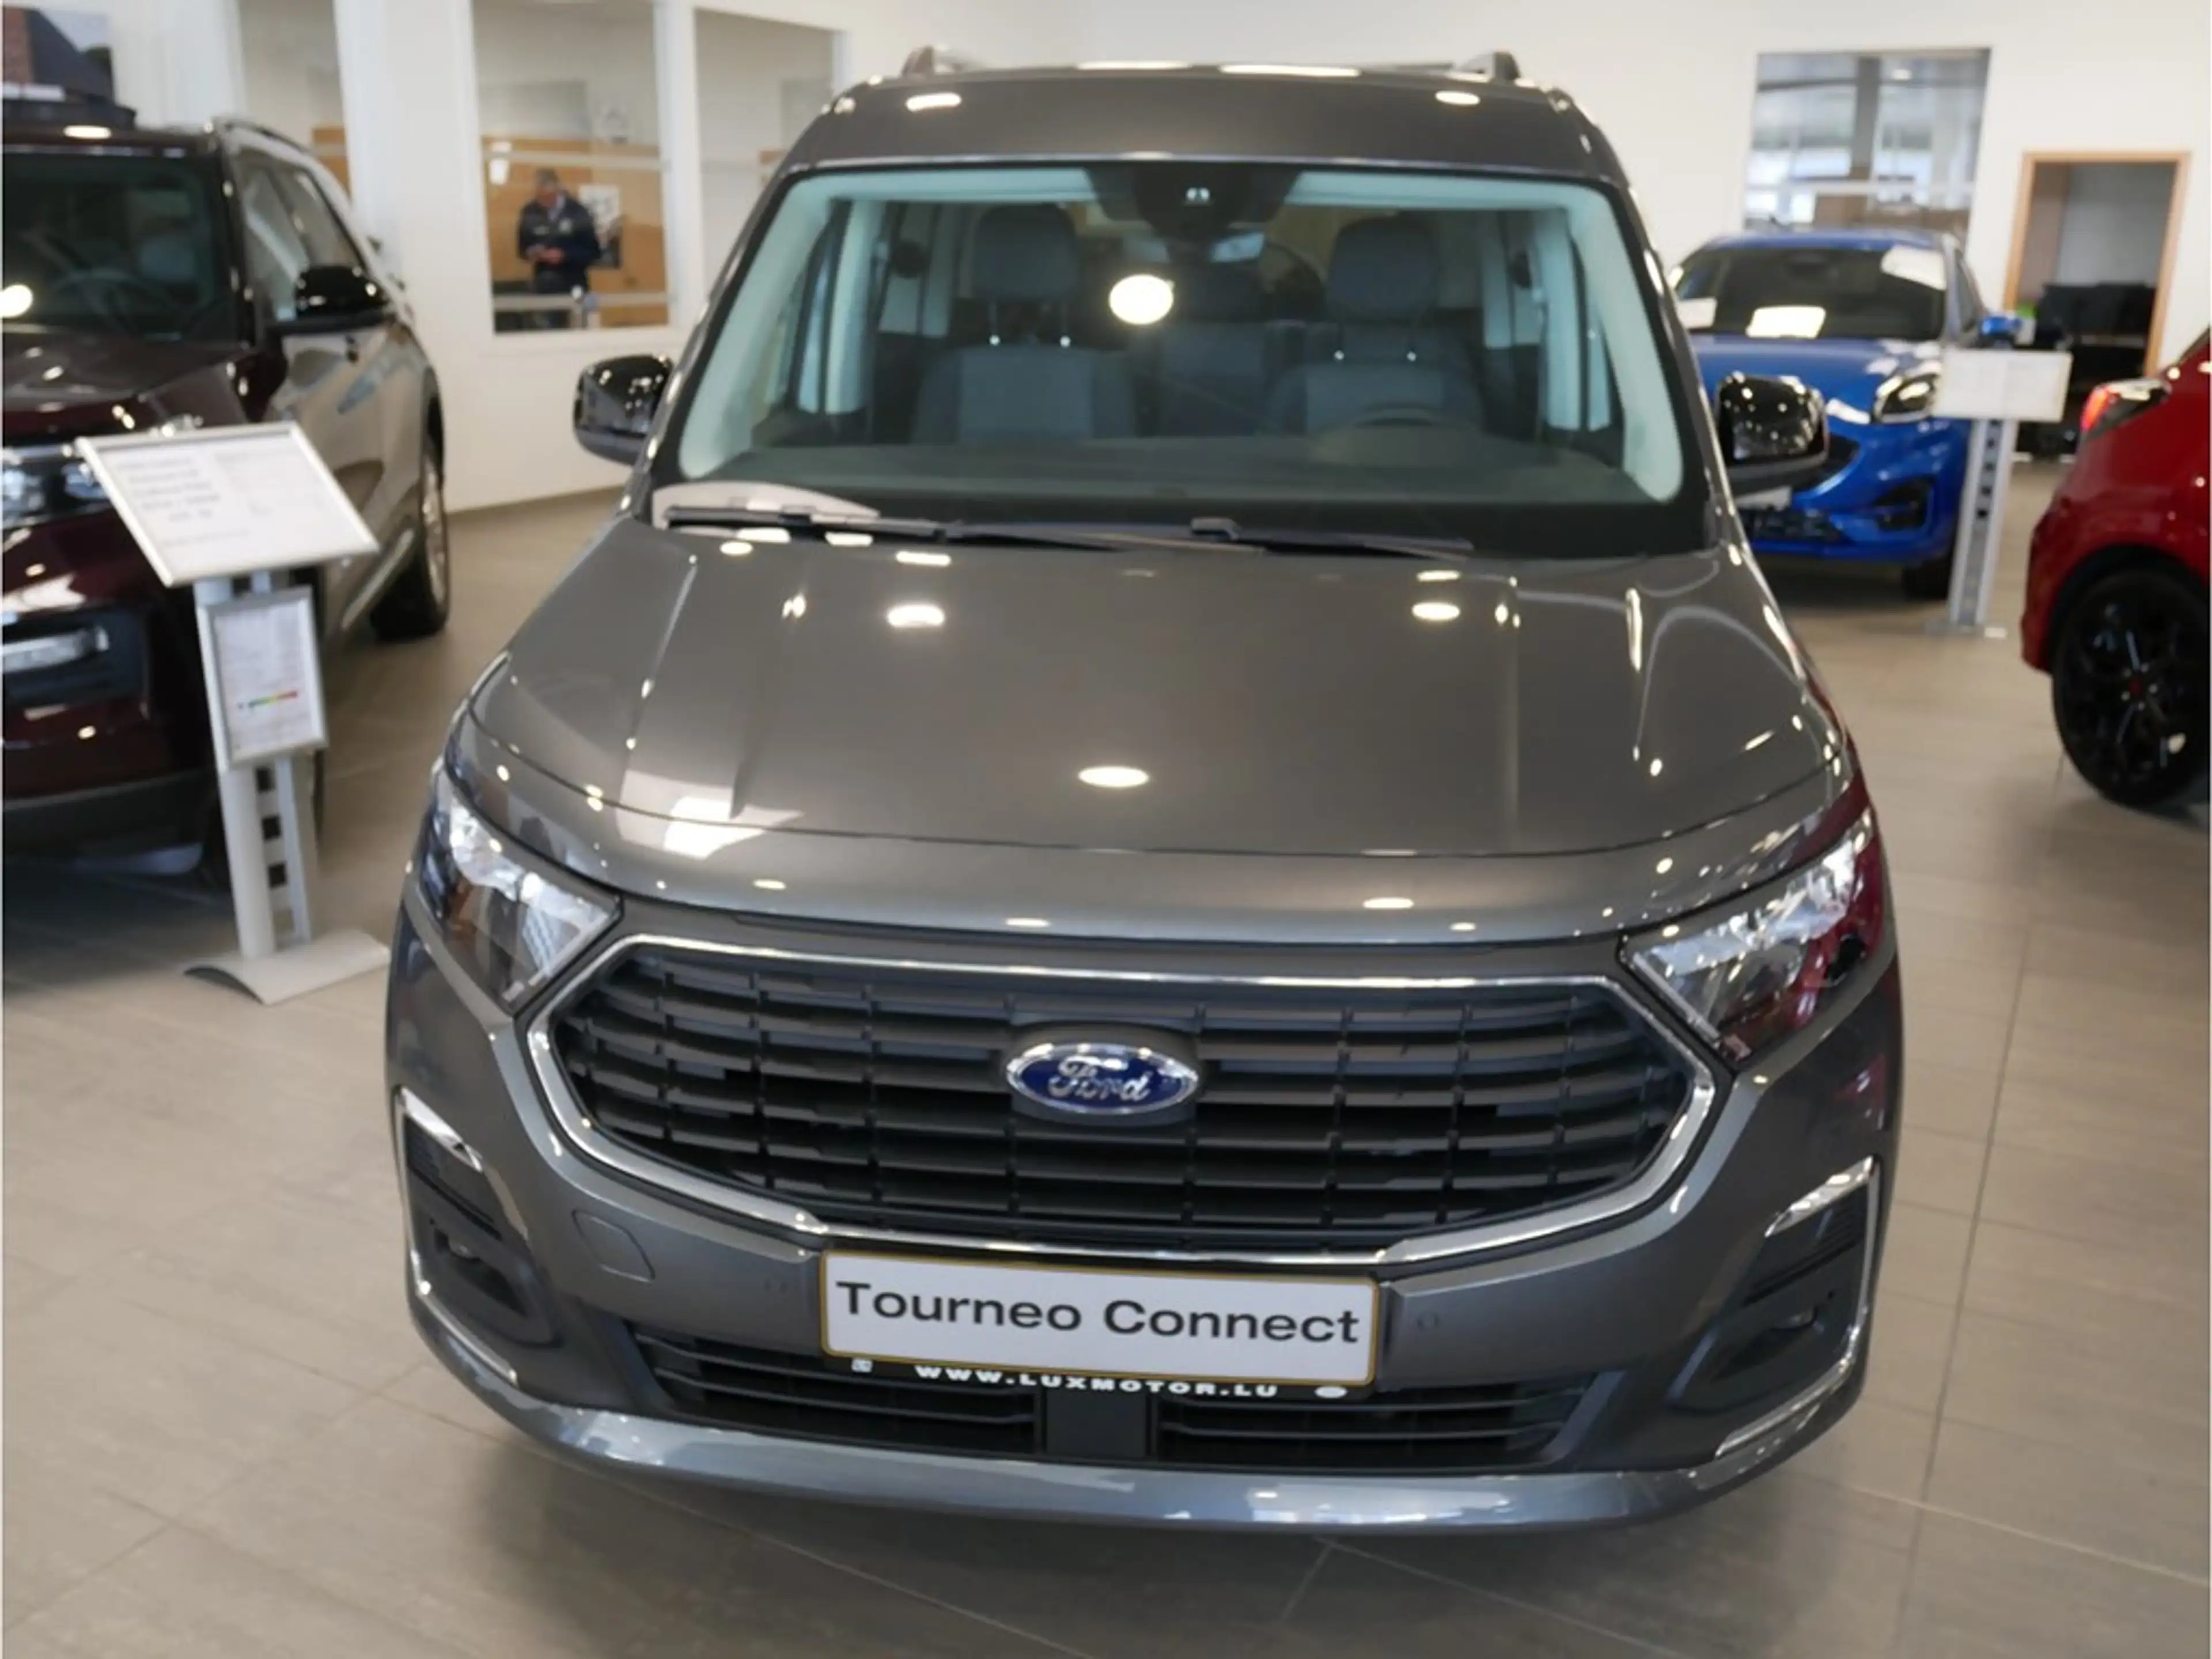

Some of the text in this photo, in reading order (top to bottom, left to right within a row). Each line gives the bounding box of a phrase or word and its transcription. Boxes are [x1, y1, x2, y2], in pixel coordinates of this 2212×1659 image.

[1048, 1055, 1153, 1101] Ford
[835, 1281, 1360, 1343] Tourneo Connect
[914, 1365, 1278, 1397] WWW.LUXMOTOR.LU
